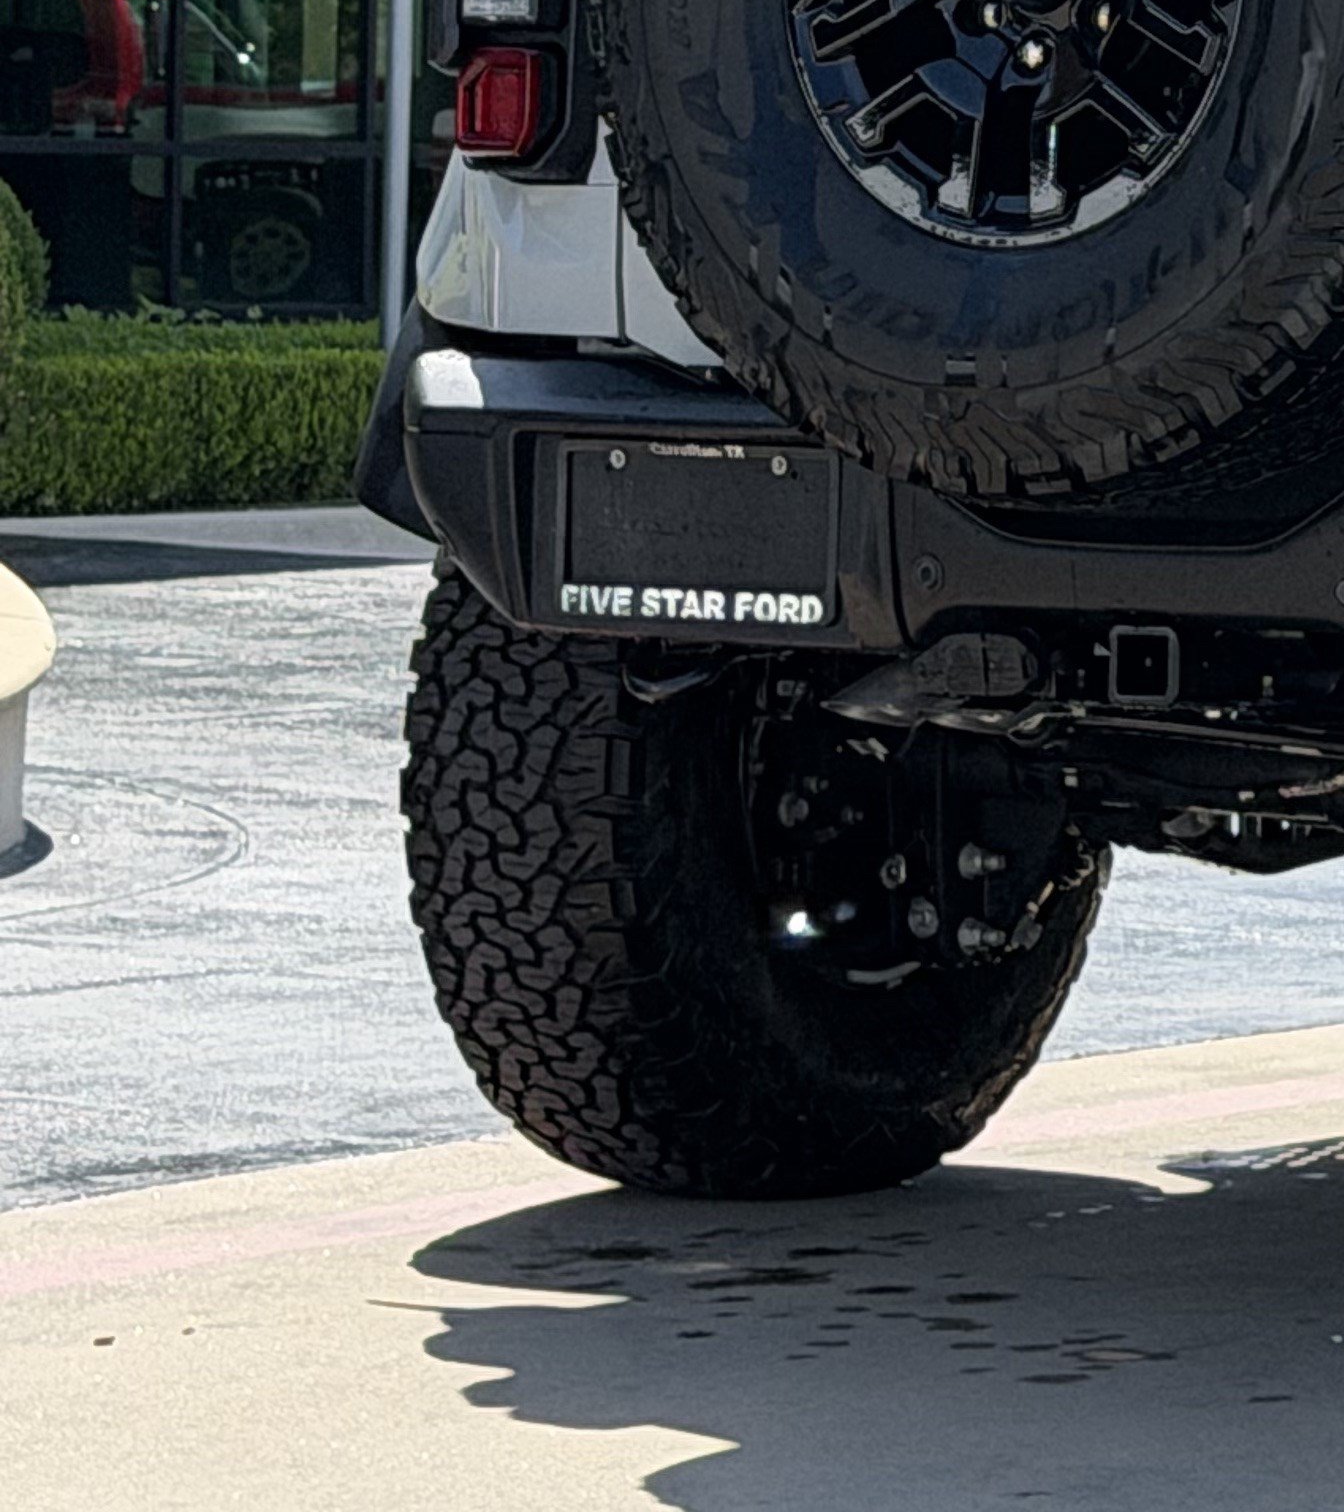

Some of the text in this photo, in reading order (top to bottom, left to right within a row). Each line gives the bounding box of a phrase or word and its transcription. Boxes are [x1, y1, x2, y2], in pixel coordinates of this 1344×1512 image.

[561, 584, 824, 624] FIVE STAR FORD
